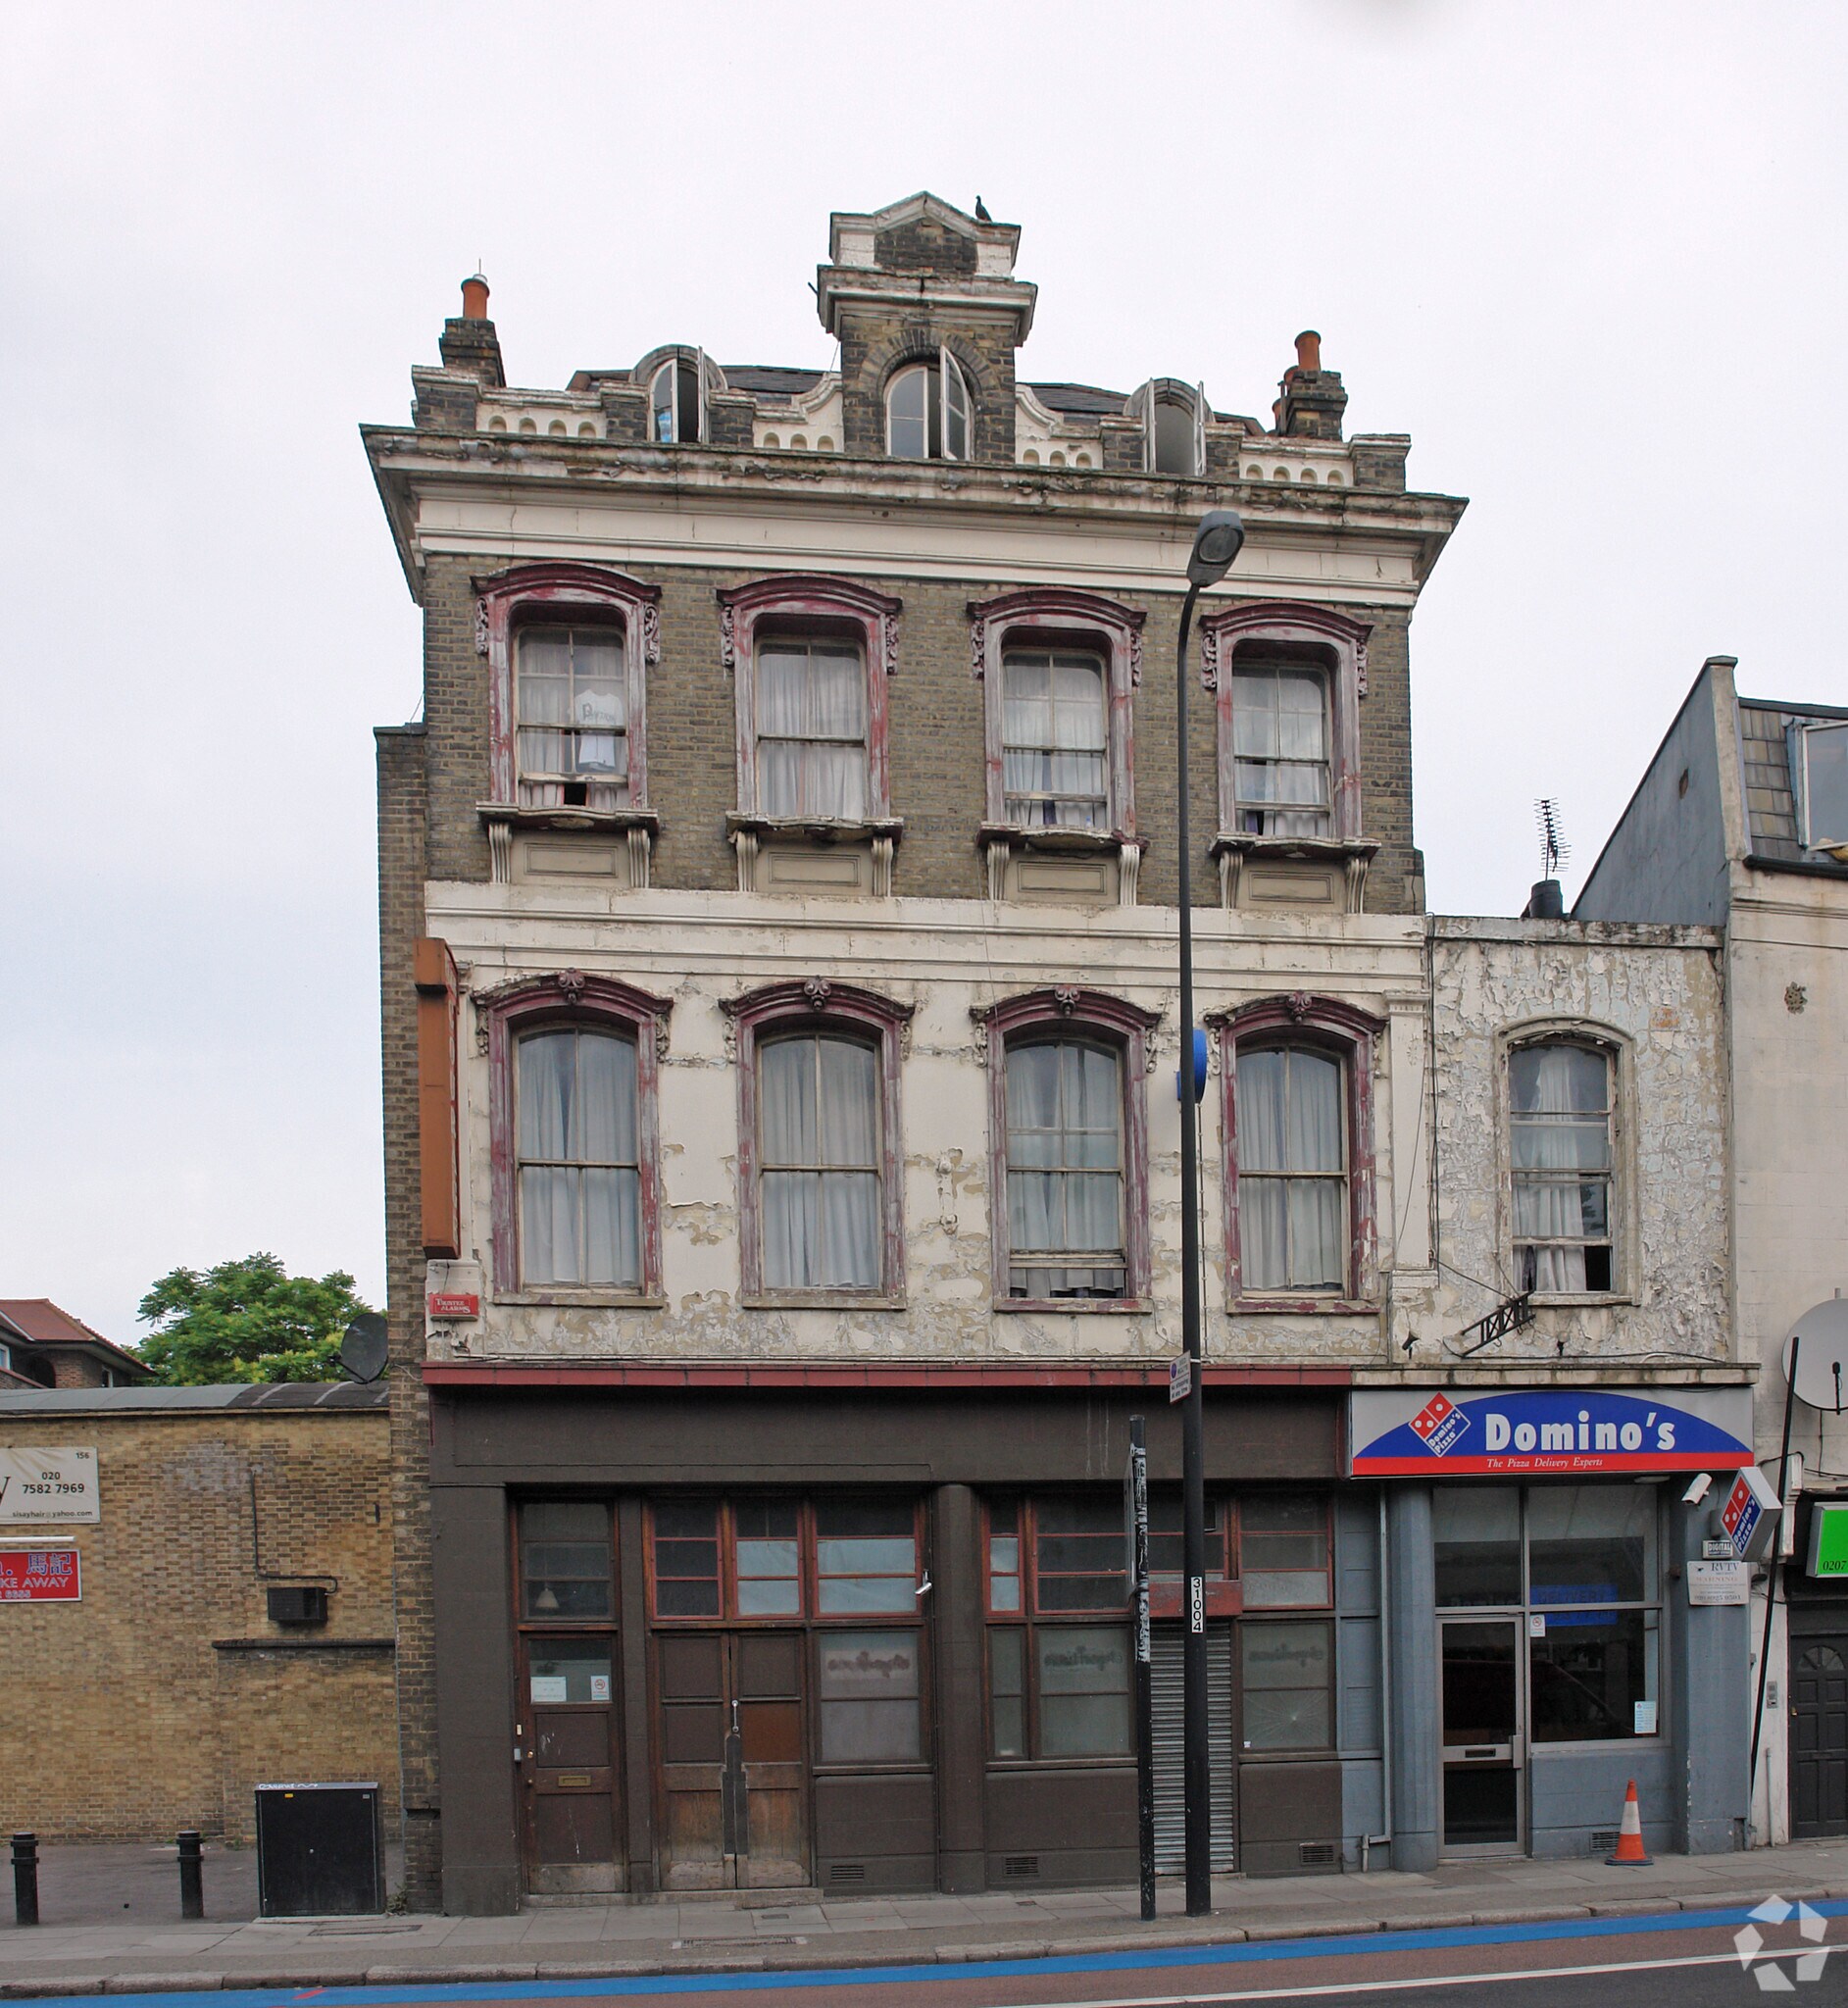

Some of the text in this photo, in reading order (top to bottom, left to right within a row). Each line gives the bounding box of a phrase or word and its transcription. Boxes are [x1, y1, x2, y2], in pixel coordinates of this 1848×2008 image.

[1427, 1412, 1462, 1448] Domino's
[1485, 1410, 1676, 1452] Domino's
[1433, 1431, 1457, 1454] Pizza
[1487, 1457, 1603, 1470] The Pizza Delivery Experts
[41, 1472, 61, 1481] 020
[23, 1483, 85, 1494] 7582 7969
[1733, 1499, 1755, 1543] Domino's
[1737, 1523, 1752, 1551] Pizza
[1708, 1542, 1731, 1552] DIGITAL
[1822, 1560, 1847, 1571] 0207
[22, 1577, 70, 1588] AWAY
[1193, 1578, 1202, 1632] 31004
